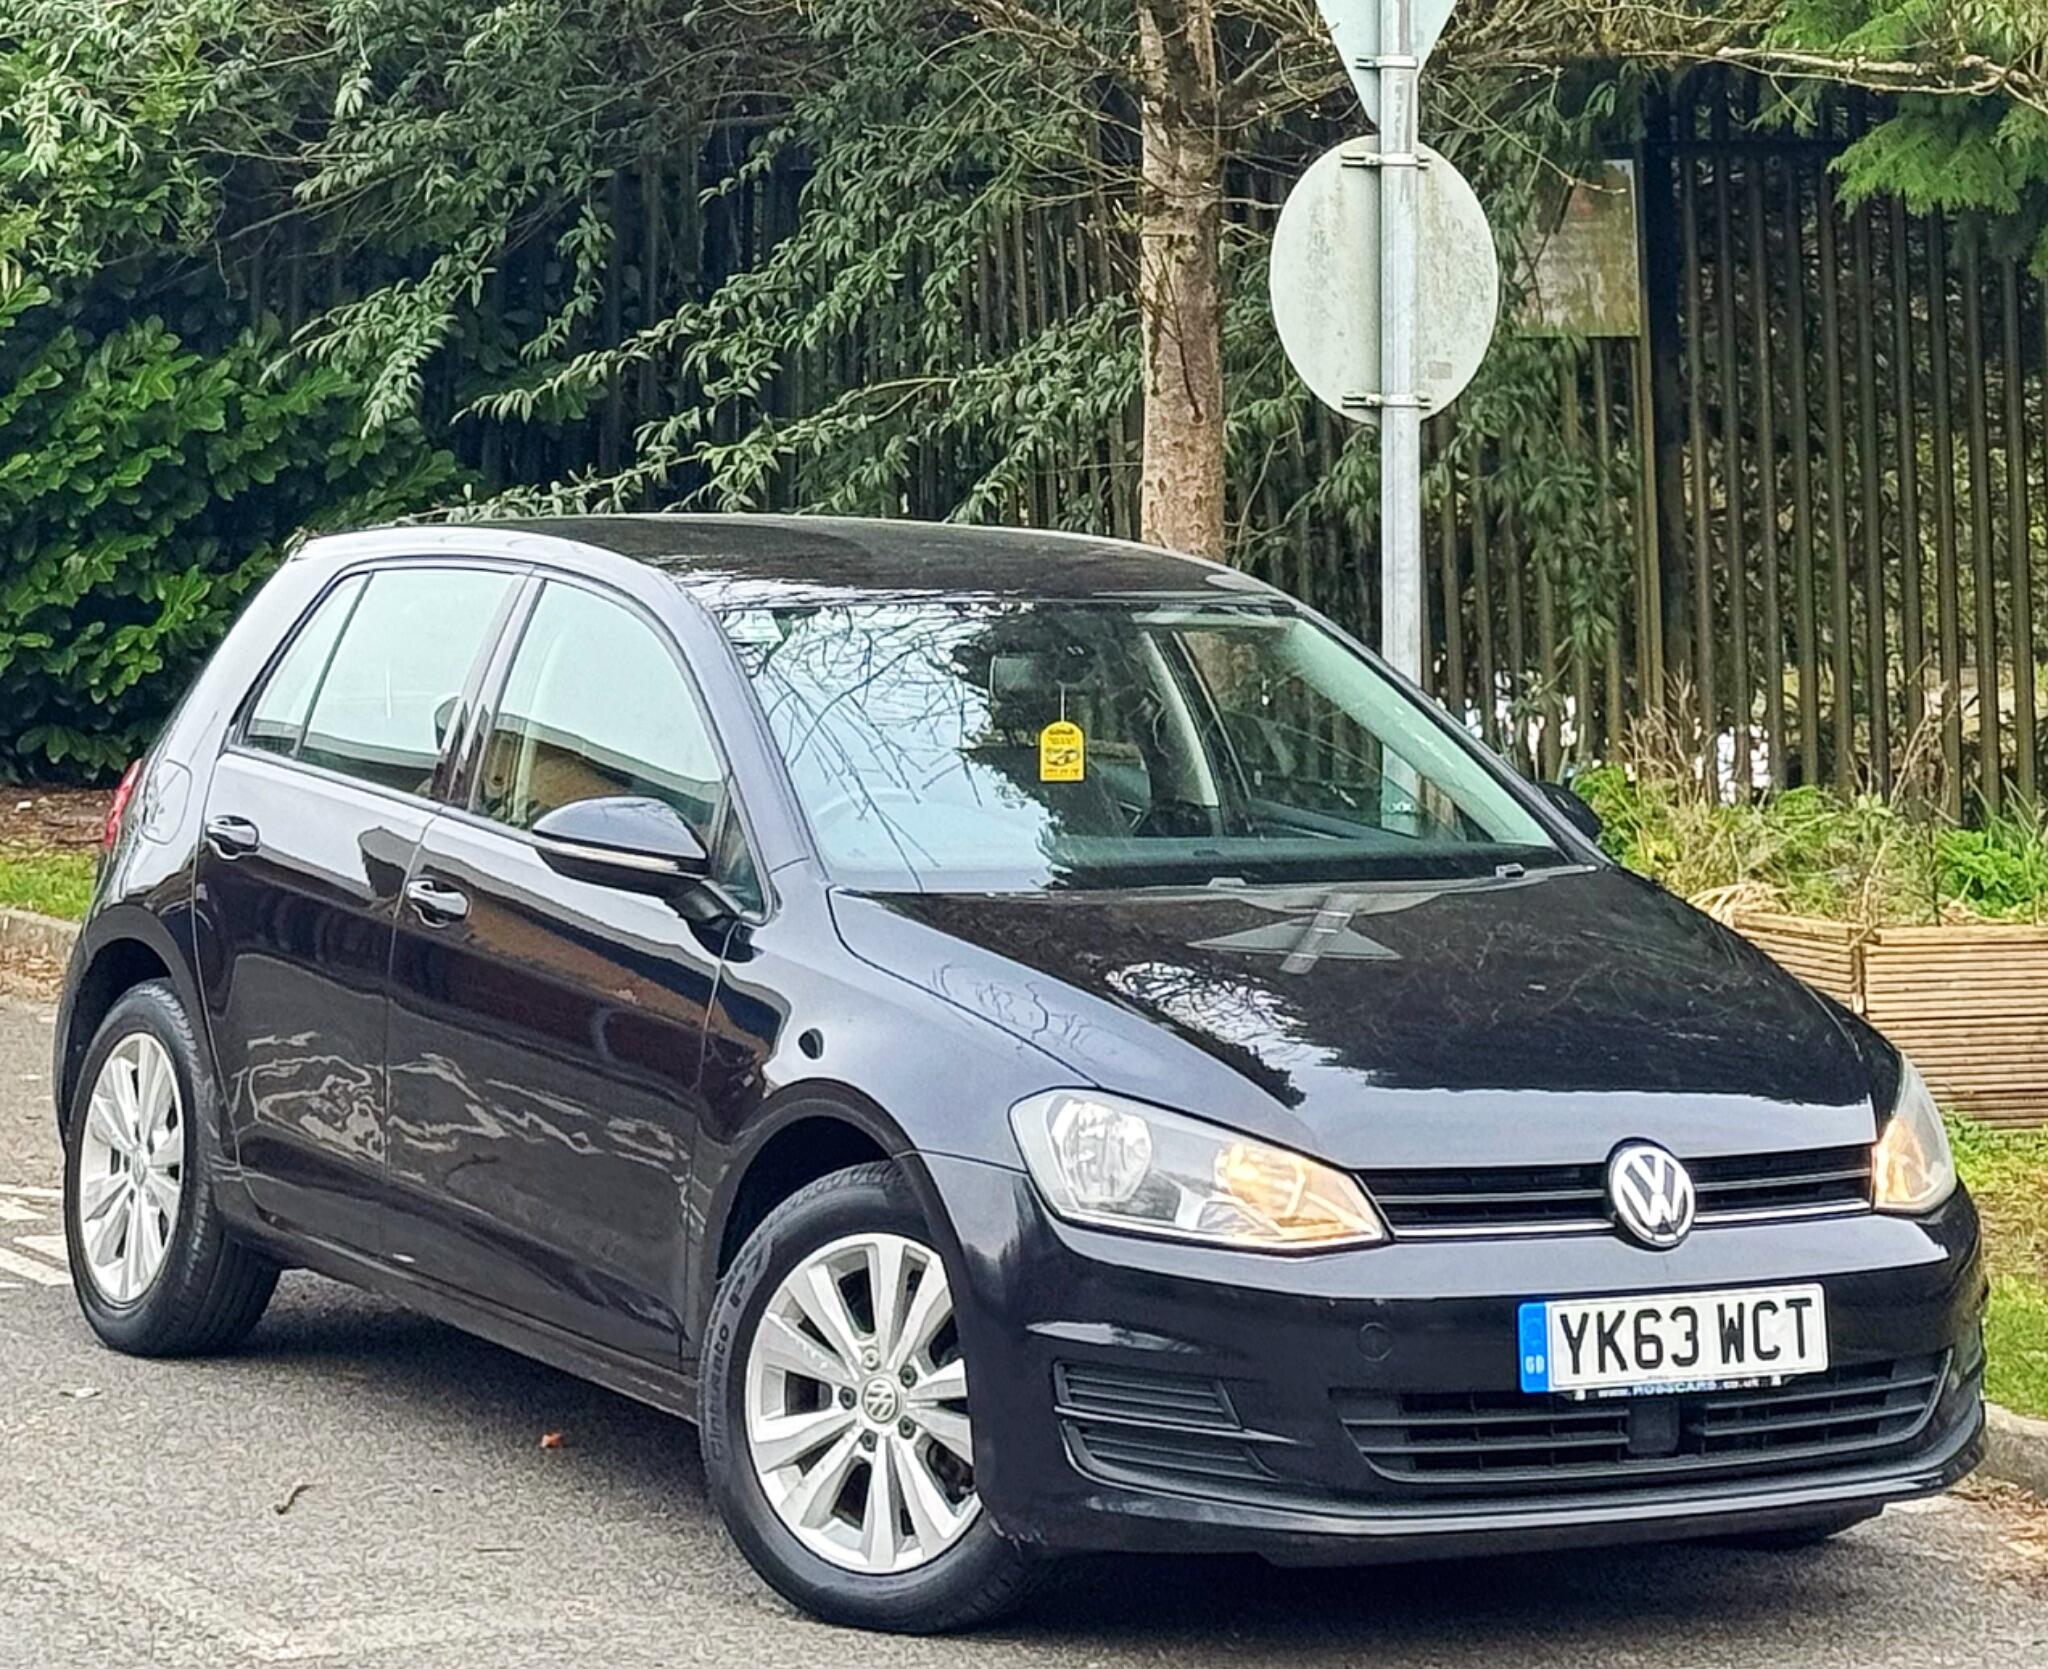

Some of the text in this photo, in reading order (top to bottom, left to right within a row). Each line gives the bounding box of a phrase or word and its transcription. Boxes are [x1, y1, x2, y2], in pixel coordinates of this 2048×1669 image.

[1611, 1147, 1694, 1244] VW
[1559, 1297, 1812, 1375] YK63 WCT
